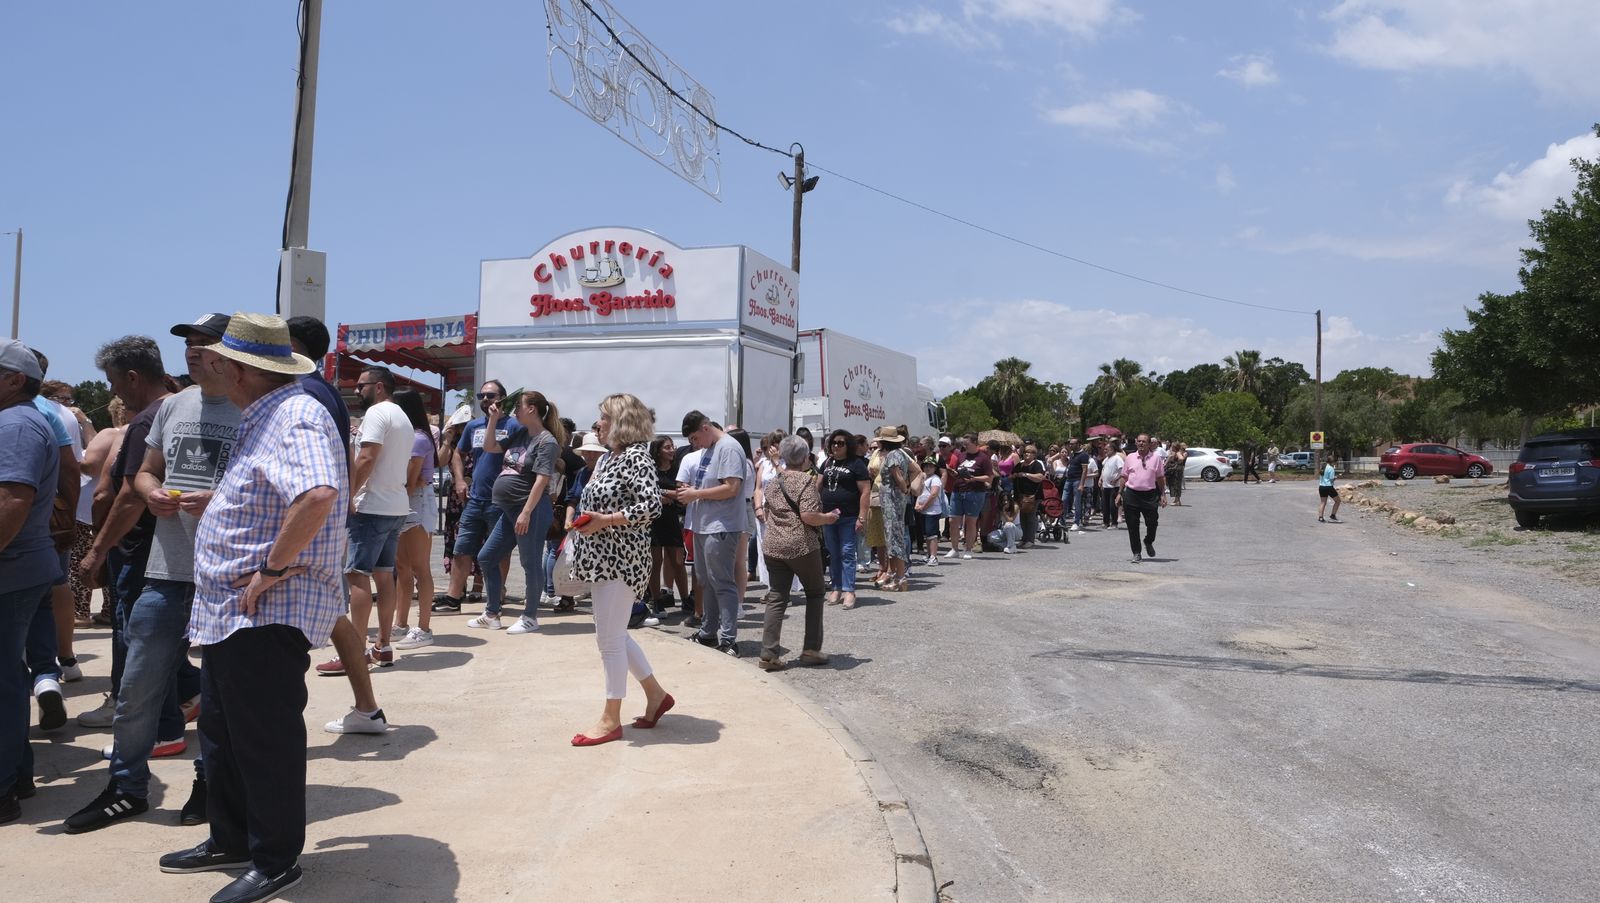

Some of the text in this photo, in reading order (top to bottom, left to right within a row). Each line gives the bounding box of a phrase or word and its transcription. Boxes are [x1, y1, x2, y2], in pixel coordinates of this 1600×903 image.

[534, 240, 674, 283] Churrería
[589, 289, 676, 316] Garrido
[769, 307, 795, 328] Garrido
[862, 403, 885, 421] Garrido
[181, 463, 207, 472] adidas
